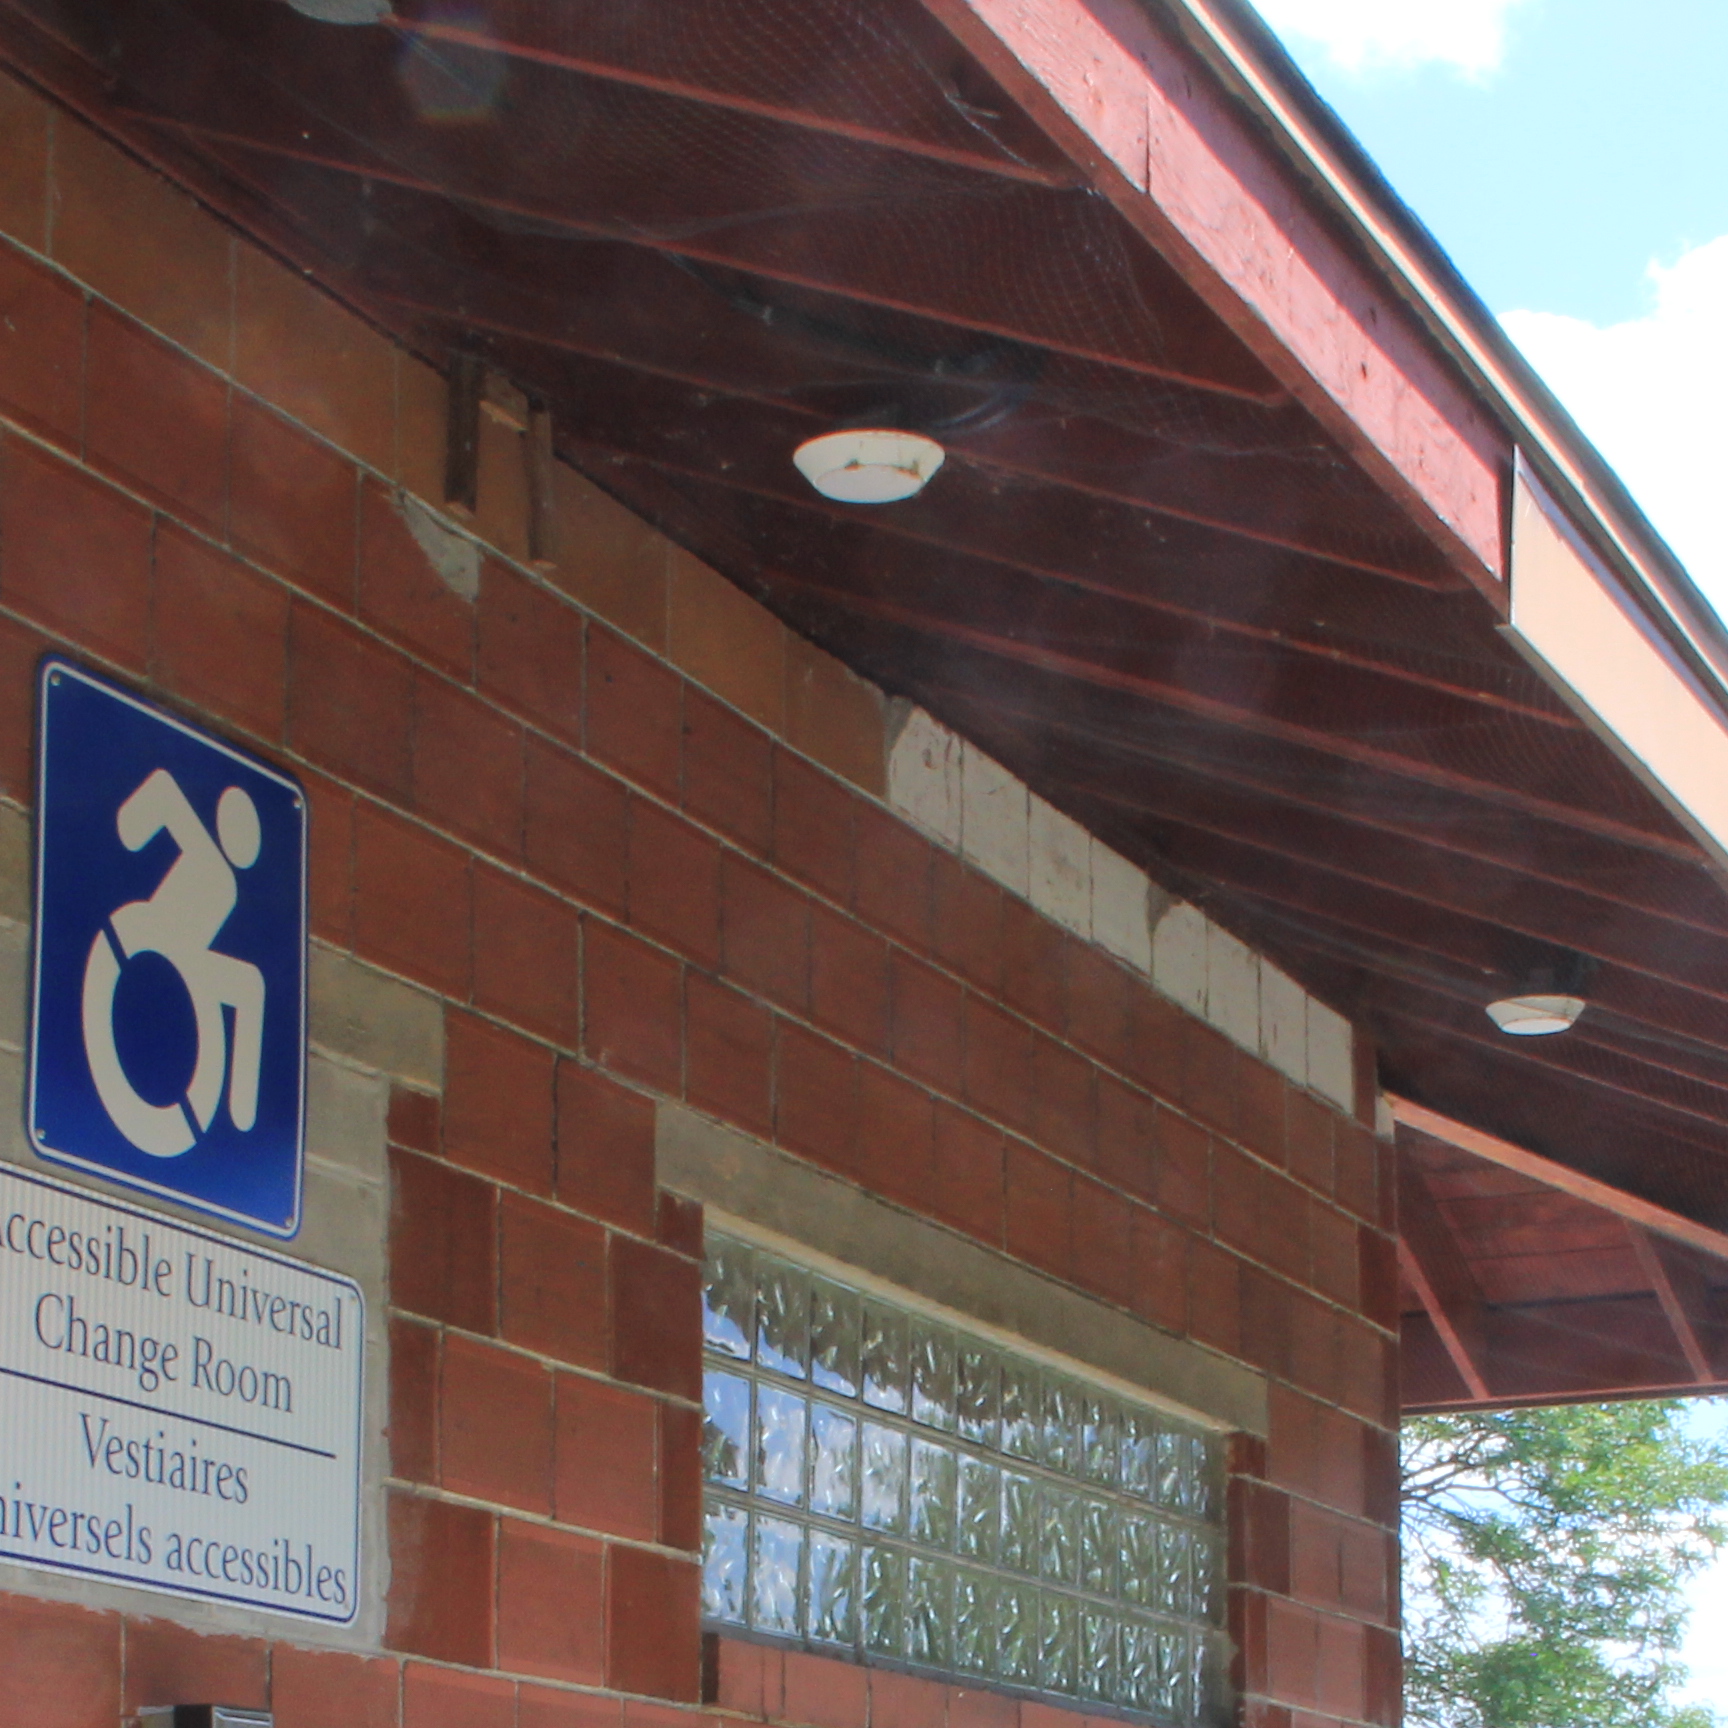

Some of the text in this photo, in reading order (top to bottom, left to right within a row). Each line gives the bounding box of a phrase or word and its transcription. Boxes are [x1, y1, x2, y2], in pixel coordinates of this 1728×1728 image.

[185, 1252, 343, 1350] Universal
[35, 1293, 293, 1414] Change Room
[79, 1413, 248, 1504] Vestiaires
[166, 1532, 347, 1605] accessibles
